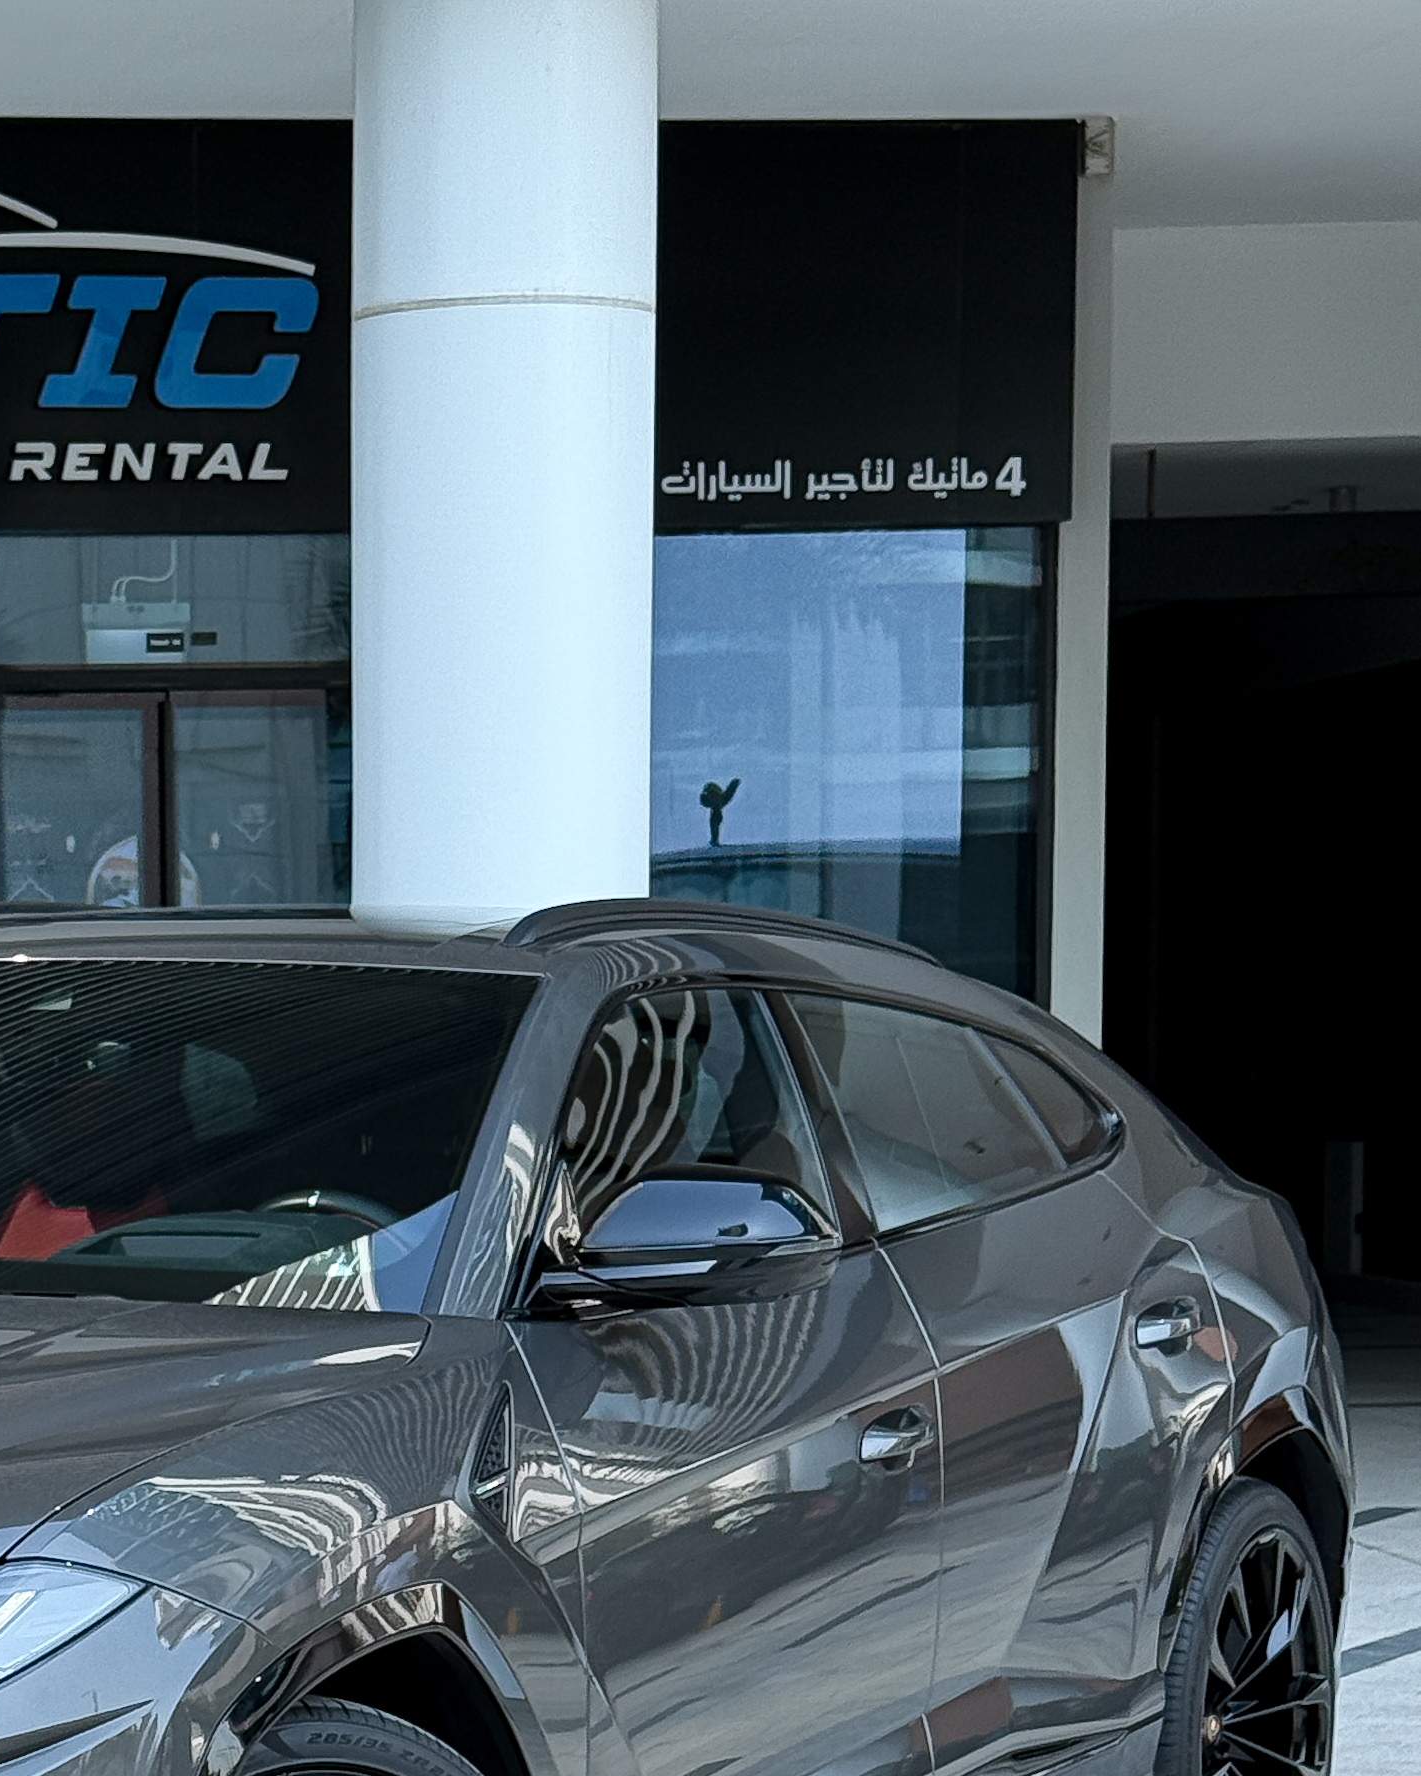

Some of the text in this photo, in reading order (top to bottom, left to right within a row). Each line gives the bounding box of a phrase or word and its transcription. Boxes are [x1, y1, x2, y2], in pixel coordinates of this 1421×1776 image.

[9, 441, 290, 482] RENTAL
[660, 456, 1027, 501] 4 ماتيك لتأجير السيارات
